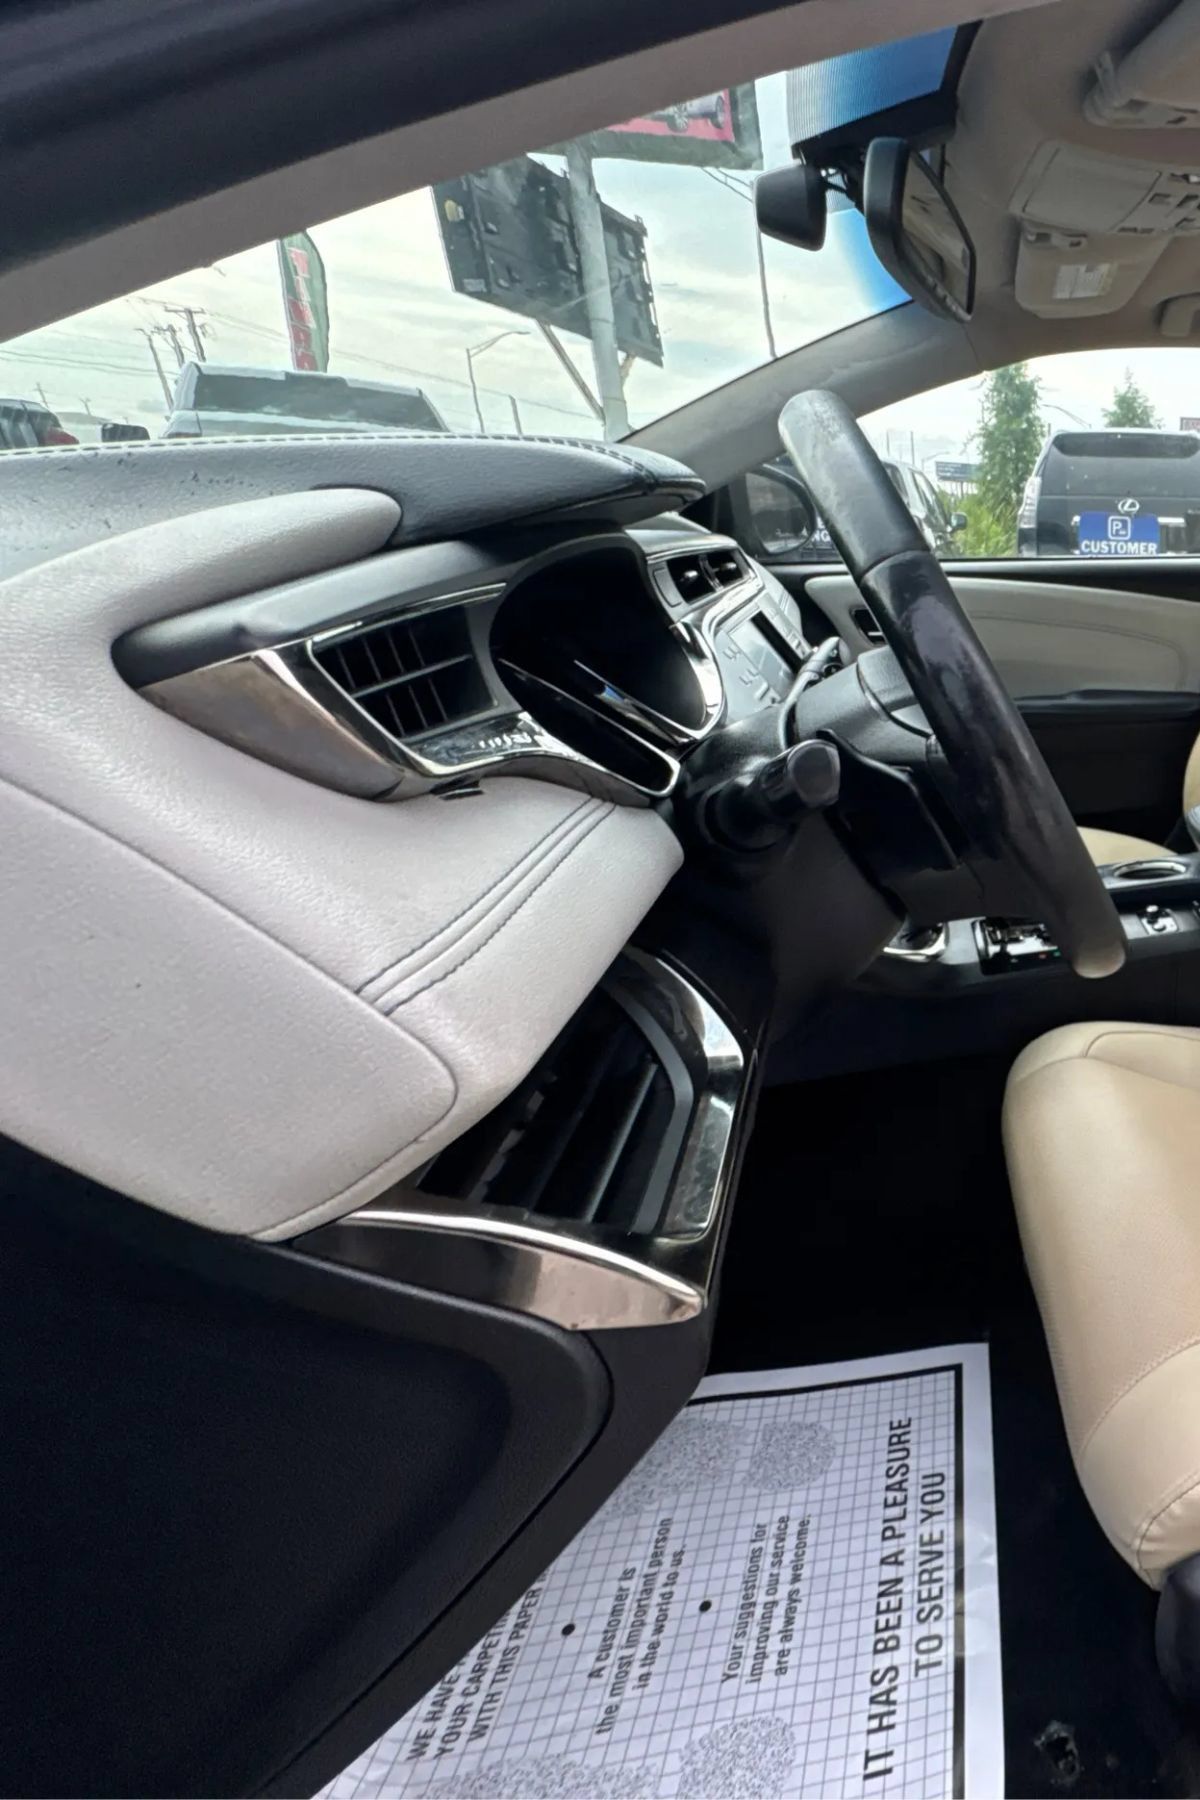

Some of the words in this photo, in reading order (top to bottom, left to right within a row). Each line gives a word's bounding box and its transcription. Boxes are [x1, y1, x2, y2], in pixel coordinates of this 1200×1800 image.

[1081, 540, 1157, 555] CUSTOMER
[881, 1417, 912, 1542] PLEASURE
[919, 1472, 946, 1524] YOU
[648, 1518, 673, 1569] person
[670, 1543, 687, 1568] us.
[771, 1515, 790, 1568] service
[789, 1513, 812, 1586] welcome.
[879, 1547, 905, 1567] A
[618, 1566, 637, 1581] is
[661, 1571, 679, 1588] to
[765, 1572, 780, 1596] our
[916, 1529, 944, 1625] SERVE
[595, 1586, 630, 1662] customer
[620, 1571, 658, 1650] important
[651, 1590, 674, 1637] world
[721, 1644, 744, 1684] Your
[734, 1546, 763, 1639] suggestions
[750, 1523, 767, 1544] for
[778, 1587, 802, 1643] always
[873, 1576, 904, 1655] BEEN
[467, 1691, 503, 1743] WITH
[492, 1645, 521, 1685] THIS
[509, 1587, 543, 1641] PAPER
[639, 1640, 661, 1668] the
[745, 1600, 779, 1684] improving
[774, 1648, 791, 1677] are
[914, 1633, 944, 1678] TO
[587, 1665, 606, 1679] A
[608, 1653, 635, 1698] most
[632, 1672, 652, 1691] in
[406, 1728, 436, 1761] WE
[424, 1674, 460, 1723] HAVE
[595, 1704, 619, 1735] the
[866, 1664, 900, 1736] HAS
[433, 1701, 473, 1760] YOUR
[862, 1748, 895, 1782] IT
